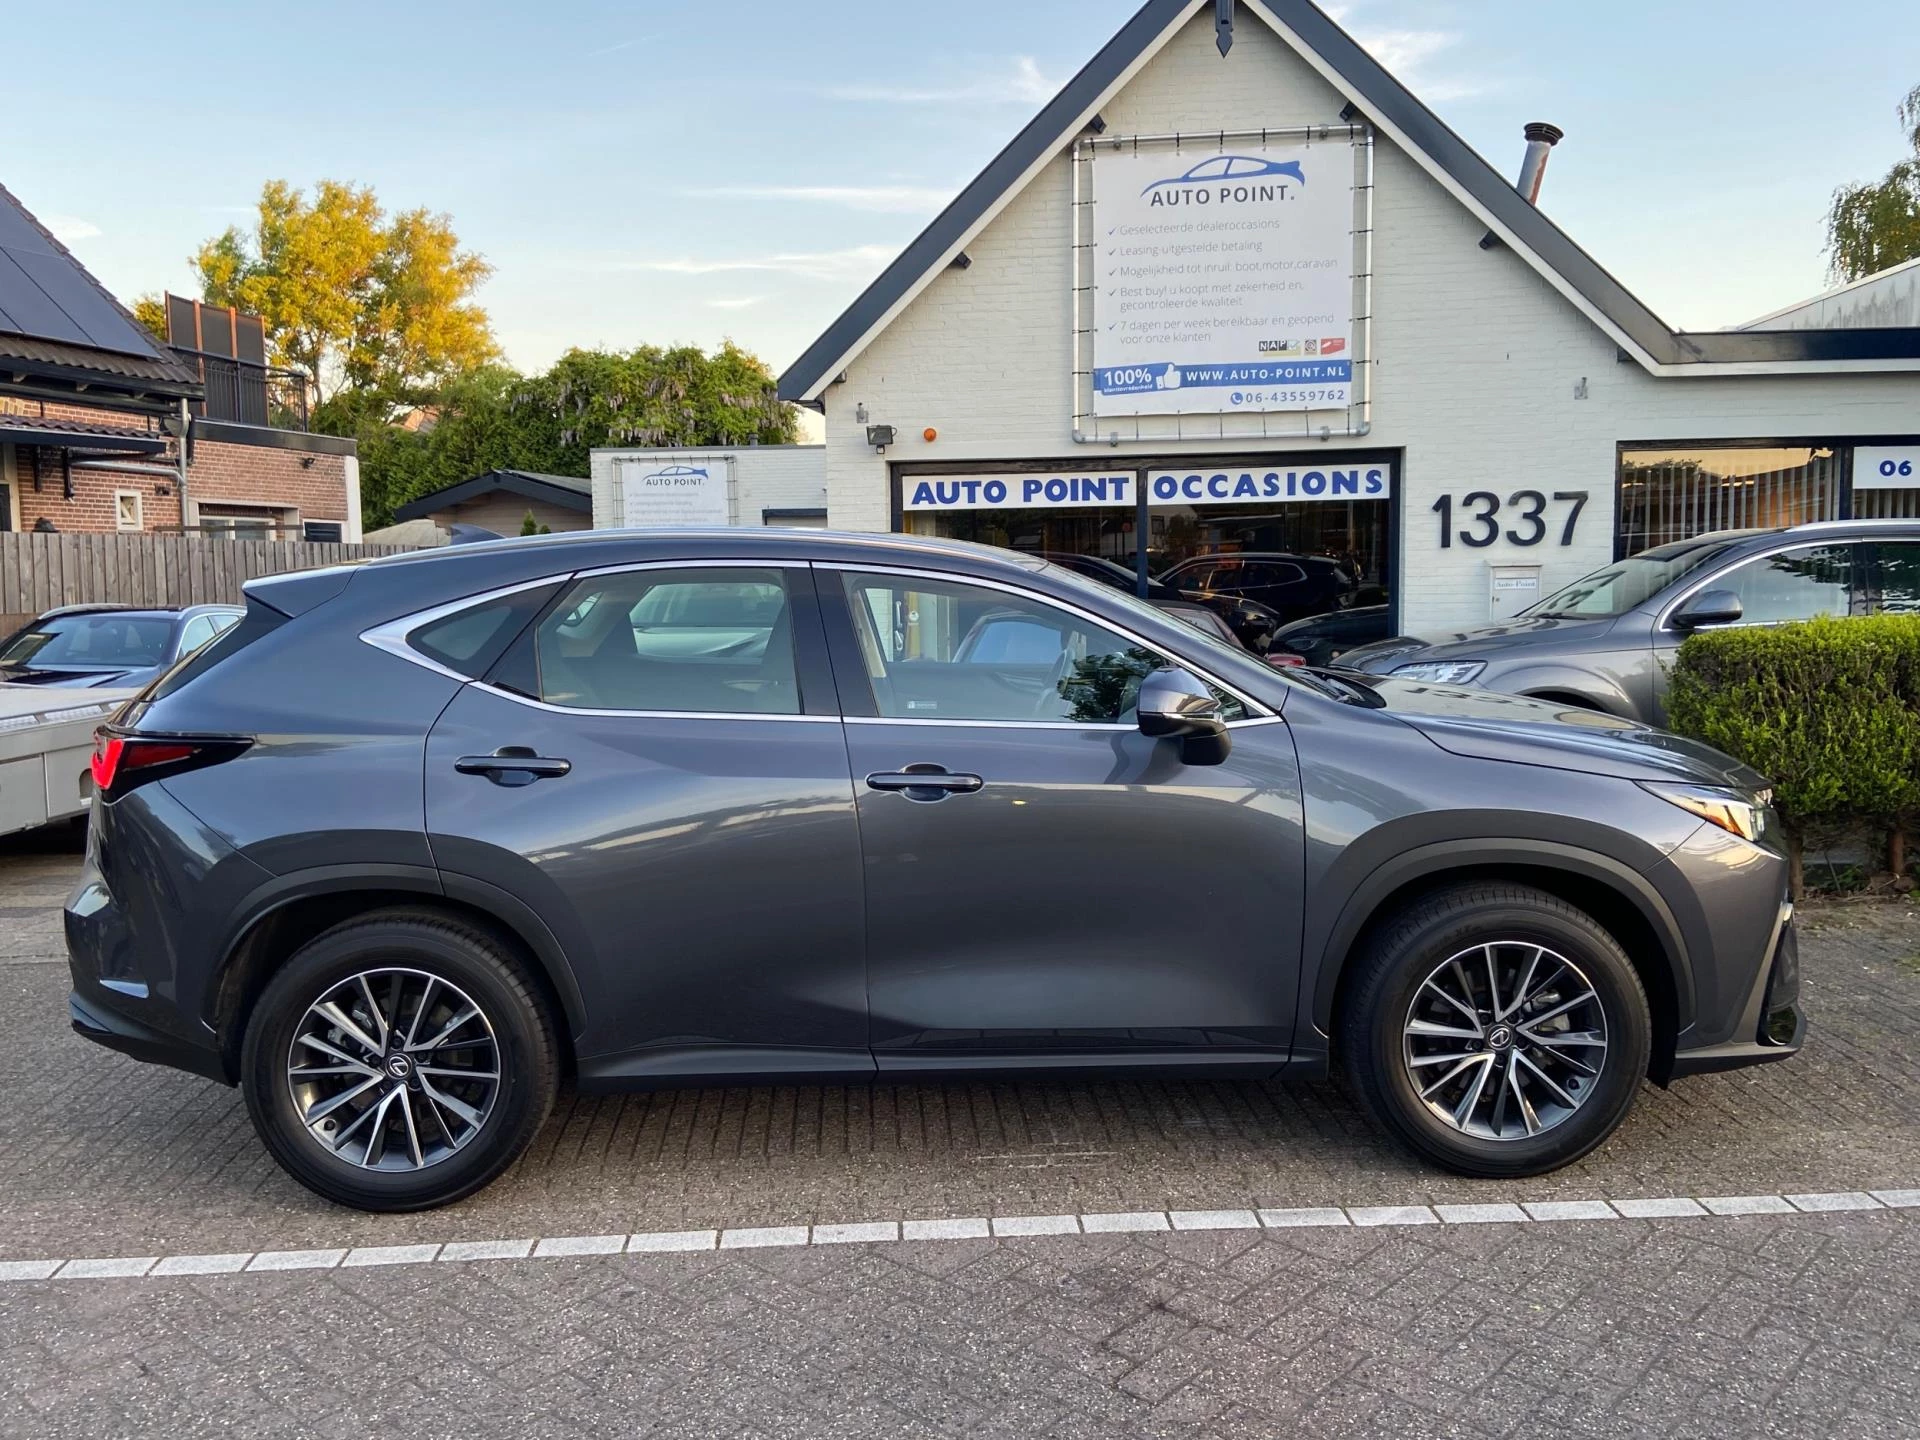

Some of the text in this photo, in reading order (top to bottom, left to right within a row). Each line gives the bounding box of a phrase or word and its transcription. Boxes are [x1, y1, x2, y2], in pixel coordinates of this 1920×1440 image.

[1150, 188, 1210, 207] AUTO
[1119, 218, 1280, 236] Geselecteerde dealeroccasions
[1221, 240, 1262, 253] betaling
[1119, 263, 1184, 278] Mogelijkheid
[1187, 264, 1201, 274] tot
[1120, 287, 1143, 297] Best
[1145, 285, 1167, 298] buy!
[1179, 283, 1208, 296] koopt
[1212, 283, 1232, 293] met
[1234, 279, 1286, 292] zekerheid
[1120, 296, 1243, 313] gecontroleerde kwaliteit
[1120, 312, 1334, 333] 7 dagen per week bereikbaar en geopend
[1120, 332, 1211, 344] voor onze klanten
[1259, 340, 1286, 351] NAP
[1104, 368, 1152, 386] 100%
[1186, 366, 1345, 381] WWW.AUTO-POINT.NL
[1245, 389, 1345, 402] 06-43559762
[1879, 460, 1913, 476] 06
[646, 478, 671, 486] AUTO
[911, 469, 1384, 505] AUTO POINT OCCASIONS
[1432, 489, 1590, 549] 1337
